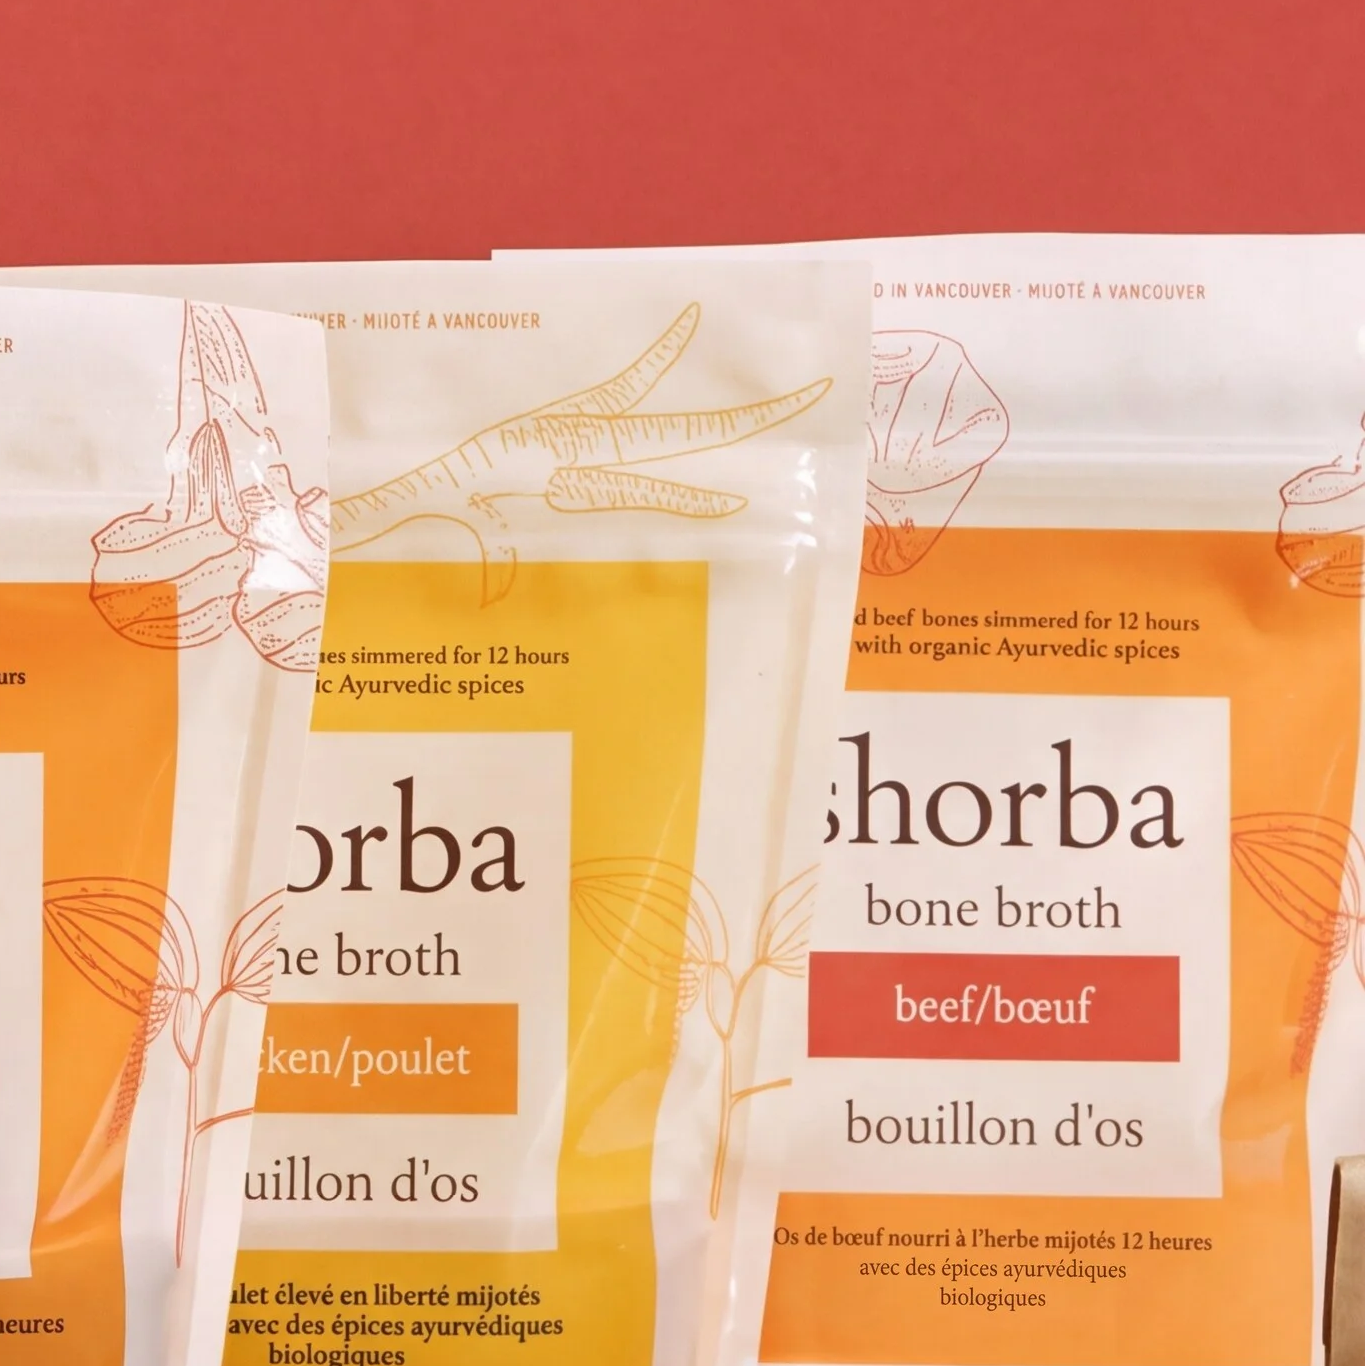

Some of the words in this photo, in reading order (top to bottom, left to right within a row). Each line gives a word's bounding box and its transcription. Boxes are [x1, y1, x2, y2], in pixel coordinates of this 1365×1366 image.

[873, 606, 916, 627] beef
[922, 607, 979, 628] bones
[983, 610, 1078, 629] simmered
[1084, 610, 1113, 630] for
[1118, 611, 1139, 631] 12
[1145, 611, 1200, 632] hours
[351, 645, 447, 665] simmered
[453, 644, 482, 665] for
[488, 646, 509, 665] 12
[515, 644, 570, 665] hours
[854, 633, 902, 655] with
[908, 636, 991, 662] organic
[995, 637, 1108, 663] Ayurvedic
[1114, 639, 1180, 665] spices
[338, 672, 452, 701] Ayurvedic
[457, 673, 525, 701] spices
[823, 731, 1185, 850] horba
[864, 882, 979, 927] bone
[994, 884, 1122, 929] broth
[334, 931, 461, 977] broth
[894, 983, 1096, 1025] beef/bœuf
[845, 1098, 1037, 1146] bouillon
[773, 1226, 799, 1246] Os
[804, 1225, 828, 1246] de
[832, 1225, 886, 1248] bœuf
[887, 1227, 951, 1248] nourri
[955, 1227, 967, 1248] à
[1044, 1229, 1116, 1255] mijotés
[1122, 1231, 1144, 1250] 12
[1148, 1230, 1213, 1251] heures
[859, 1262, 900, 1276] avec
[905, 1256, 936, 1277] des
[941, 1257, 998, 1282] épices
[1003, 1258, 1127, 1284] ayurvédiques
[274, 1282, 334, 1306] élevé
[339, 1289, 368, 1306] en
[373, 1282, 450, 1307] liberté
[456, 1284, 541, 1313] mijotés
[939, 1286, 1046, 1312] biologiques
[228, 1318, 280, 1335] avec
[285, 1312, 325, 1336] des
[331, 1313, 405, 1342] épices
[410, 1314, 564, 1344] ayurvédiques
